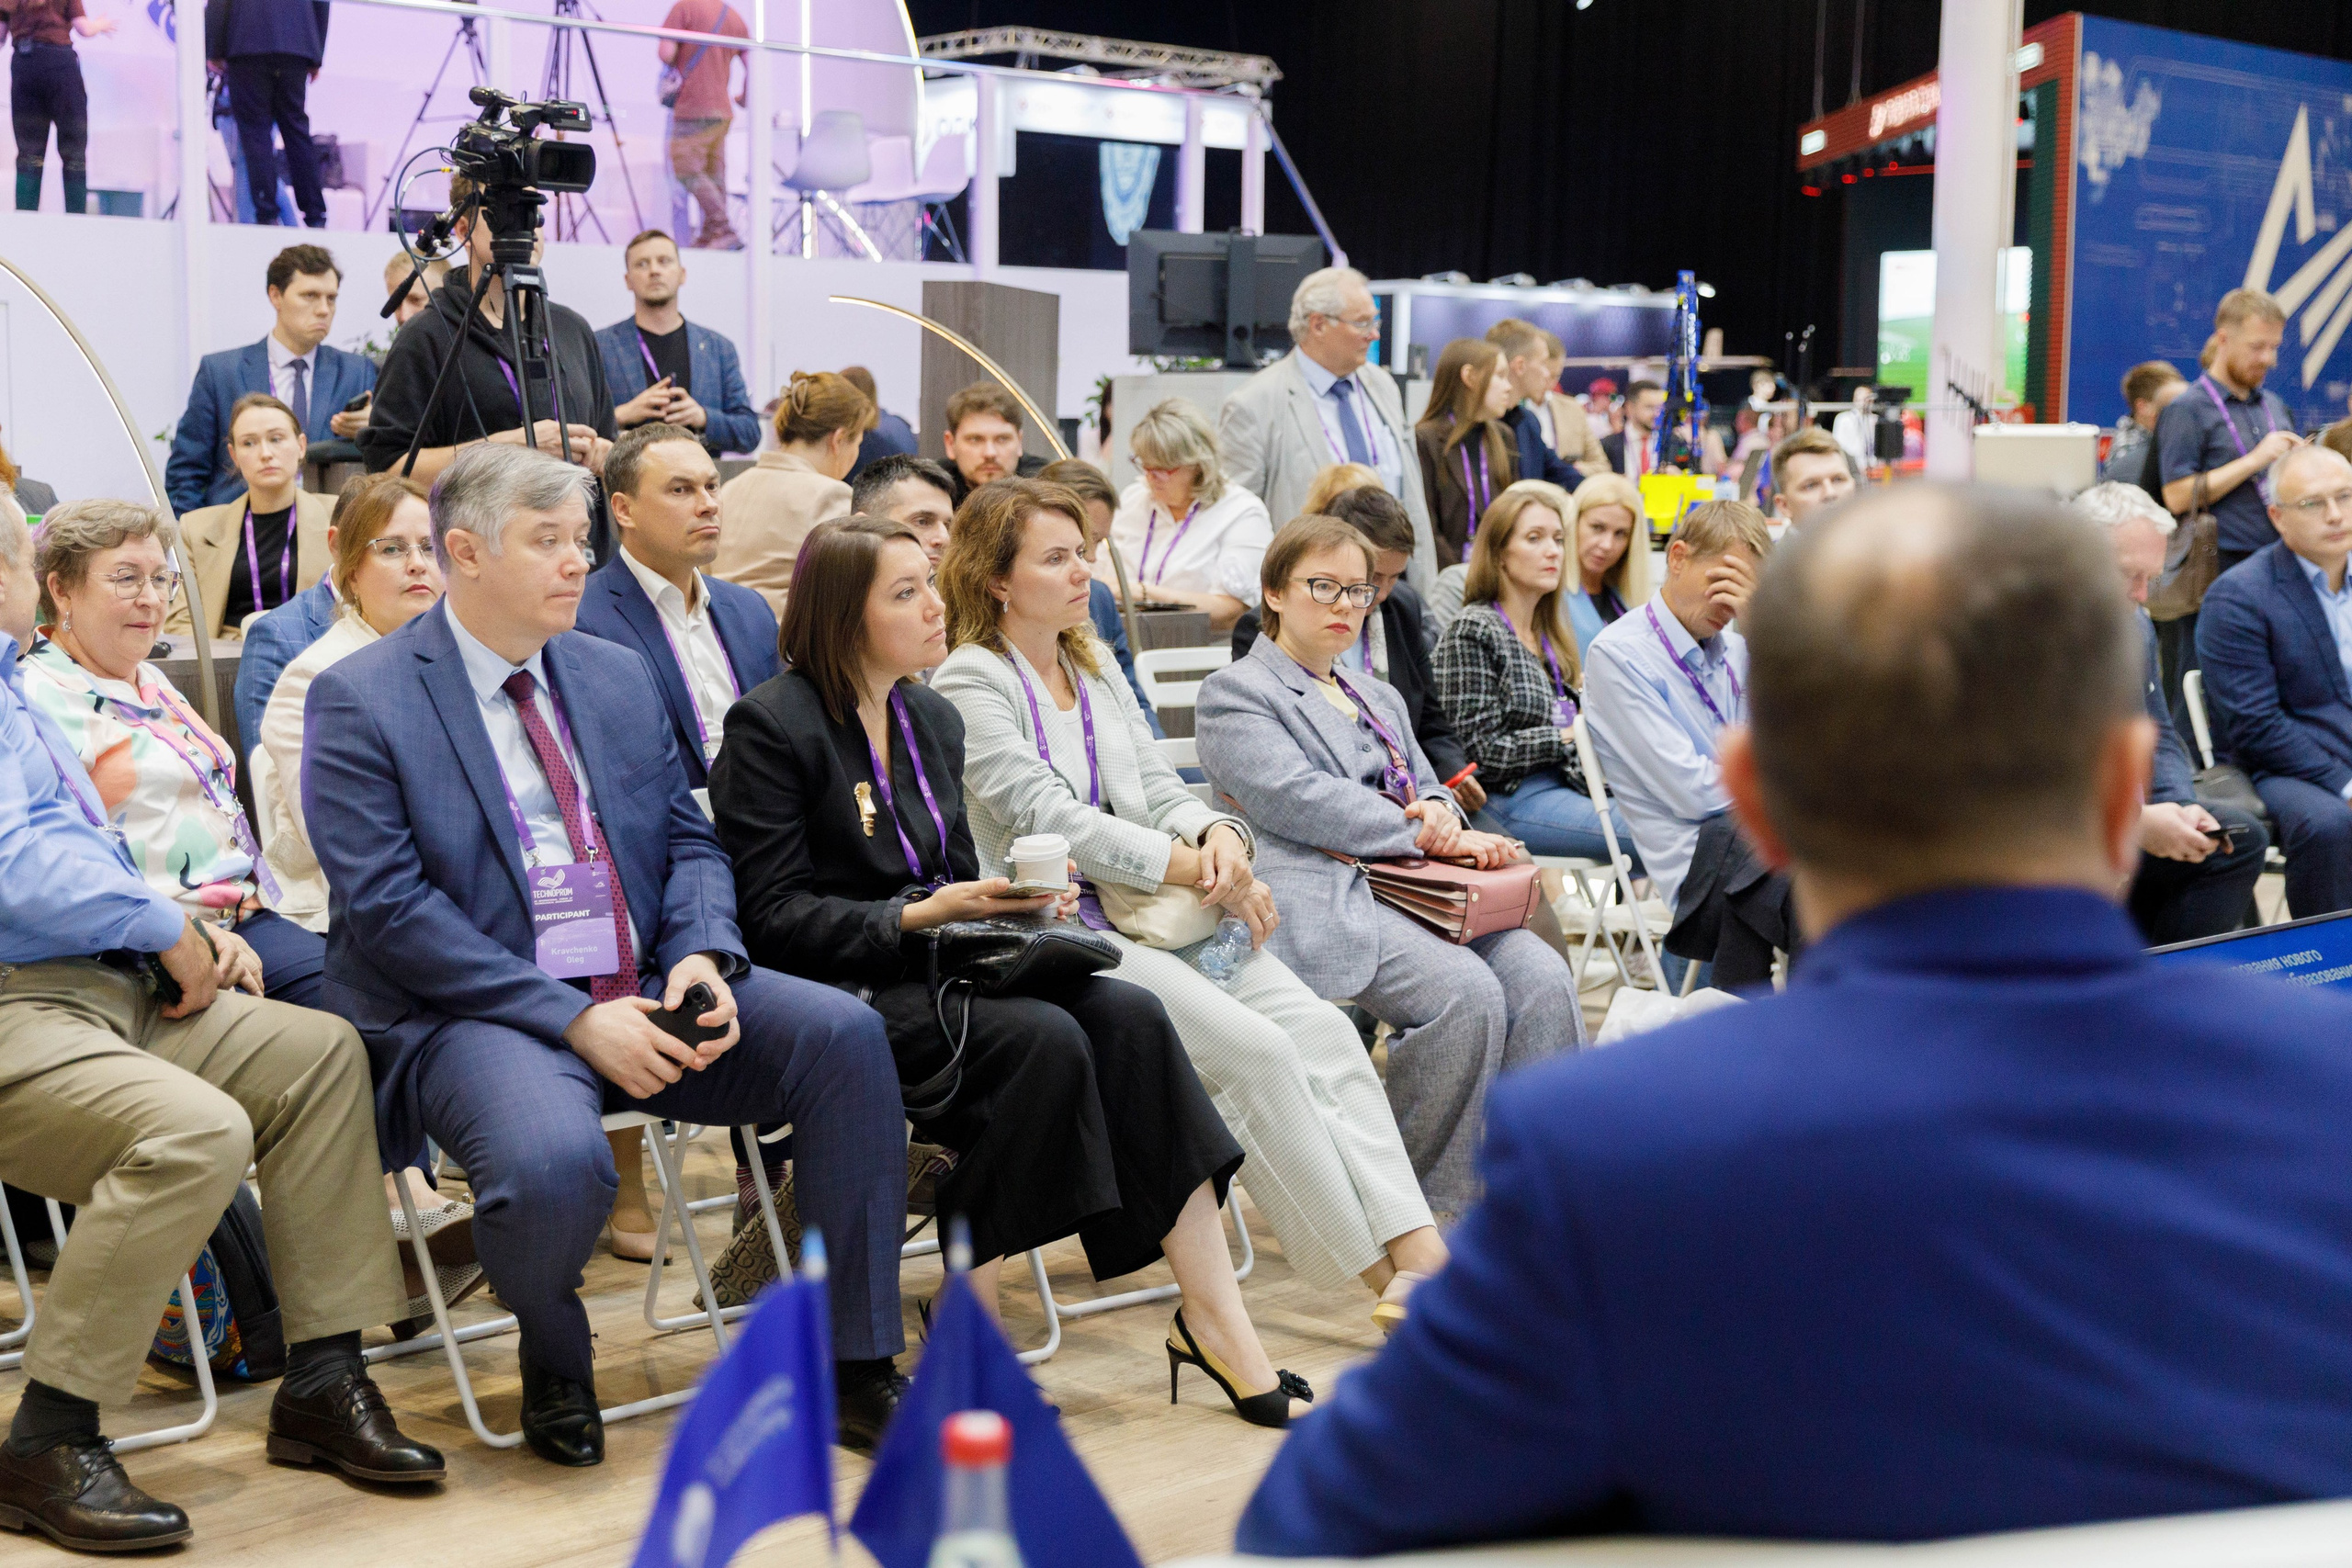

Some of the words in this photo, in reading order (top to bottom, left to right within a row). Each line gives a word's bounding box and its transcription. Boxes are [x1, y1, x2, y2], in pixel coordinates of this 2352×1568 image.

[533, 887, 573, 898] TECHNOPROM
[535, 909, 590, 921] PARTICIPANT
[551, 946, 597, 955] Kravchenko
[566, 956, 584, 964] Oleg
[2278, 949, 2323, 967] нового
